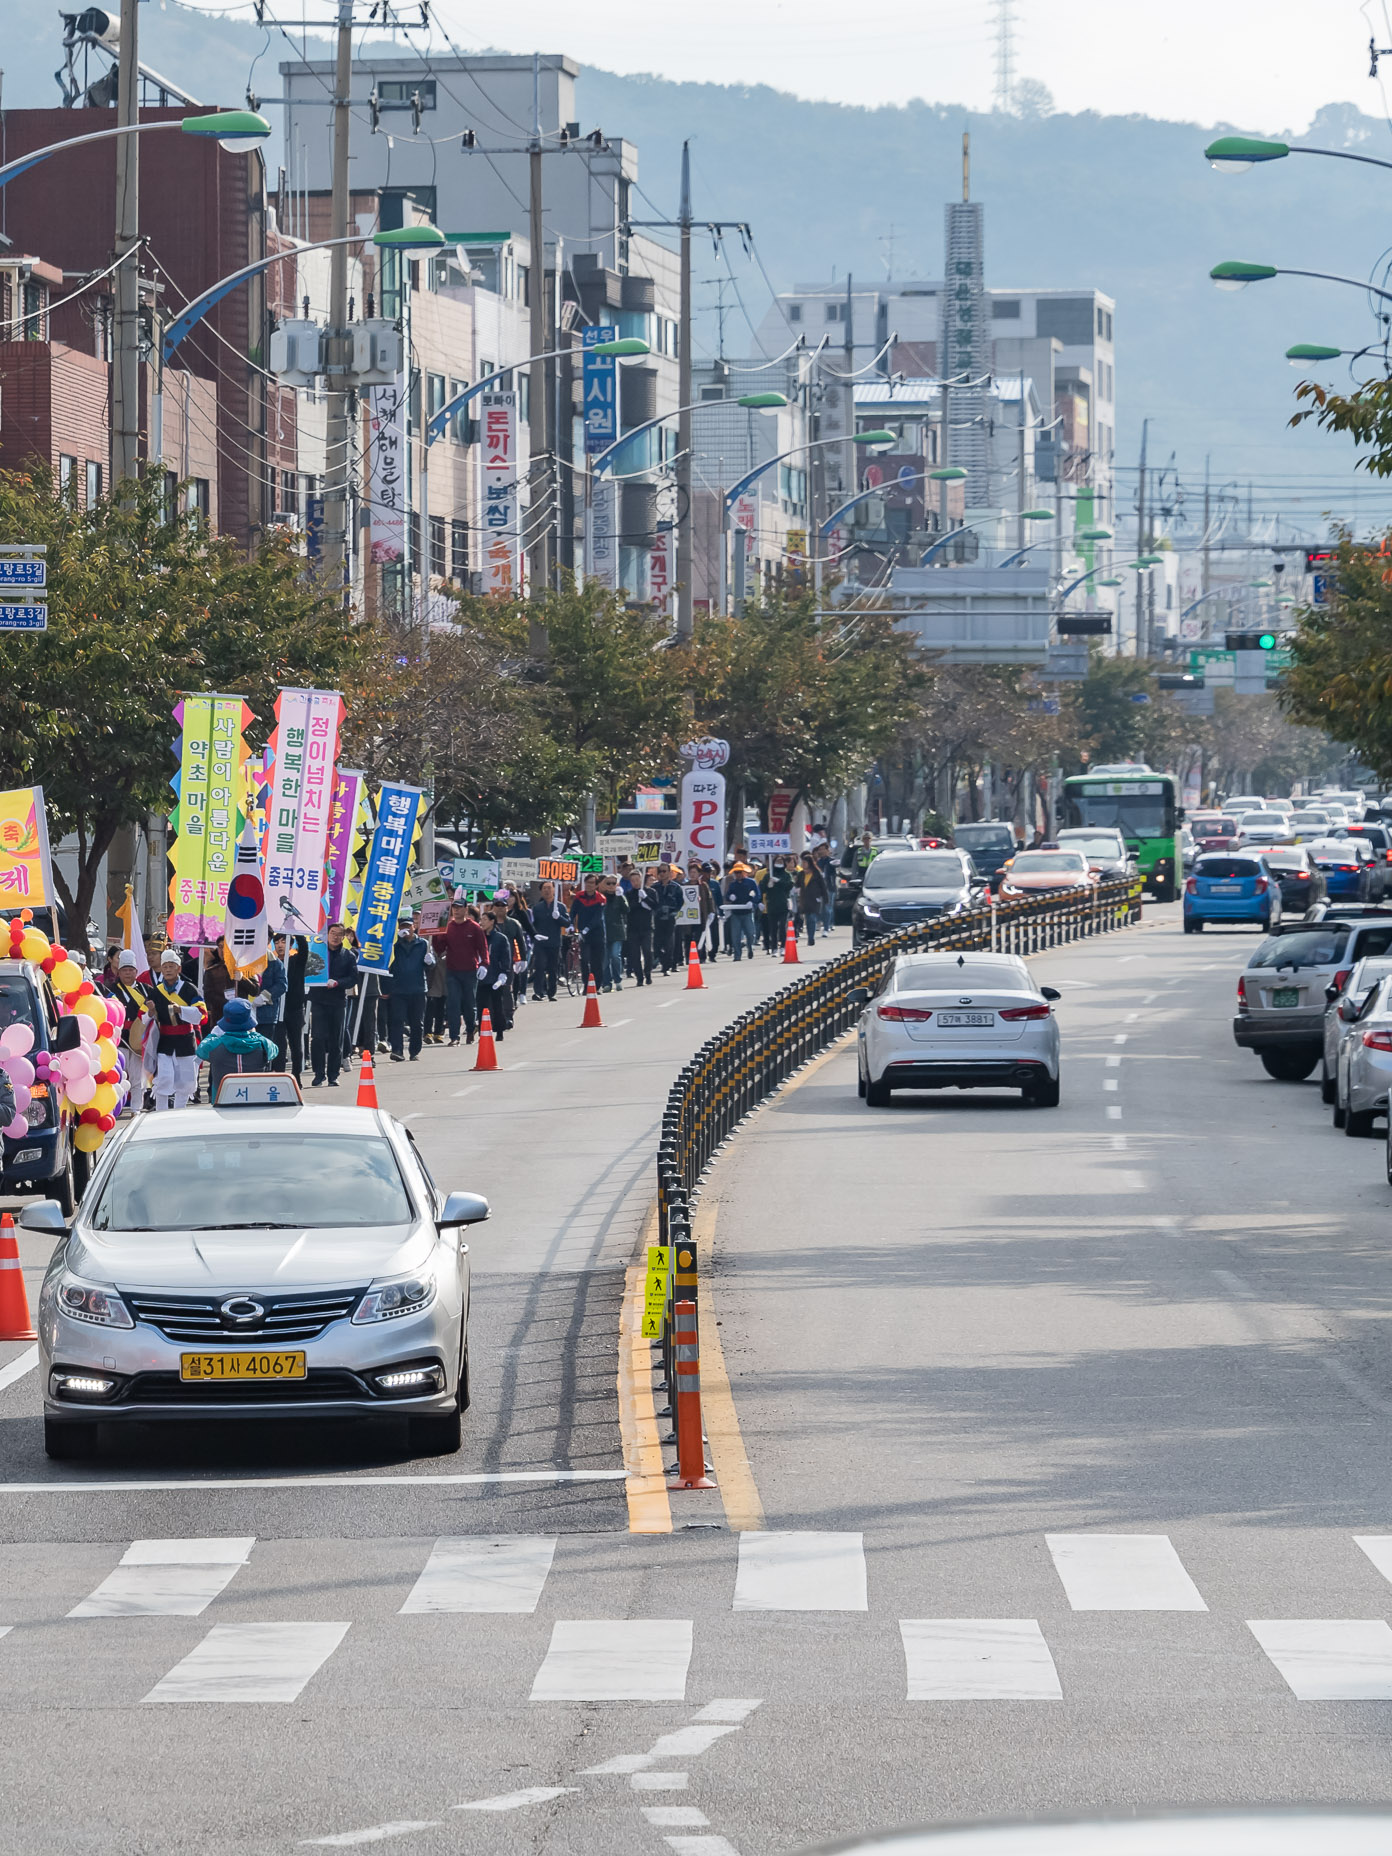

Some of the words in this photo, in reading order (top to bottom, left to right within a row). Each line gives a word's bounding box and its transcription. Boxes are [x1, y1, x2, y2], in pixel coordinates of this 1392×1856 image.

[585, 329, 613, 344] 선우
[486, 411, 510, 471] 돈까스
[27, 575, 43, 584] 5-gil
[28, 620, 44, 628] 3-gil
[187, 740, 209, 783] 약초
[212, 717, 235, 782] 사람이
[281, 727, 305, 799] 행복한
[3, 825, 20, 843] 축
[185, 792, 207, 835] 마을
[207, 786, 232, 873] 아름다운
[275, 807, 298, 854] 마을
[268, 866, 319, 891] 중곡3동
[538, 860, 578, 881] 파이팅!
